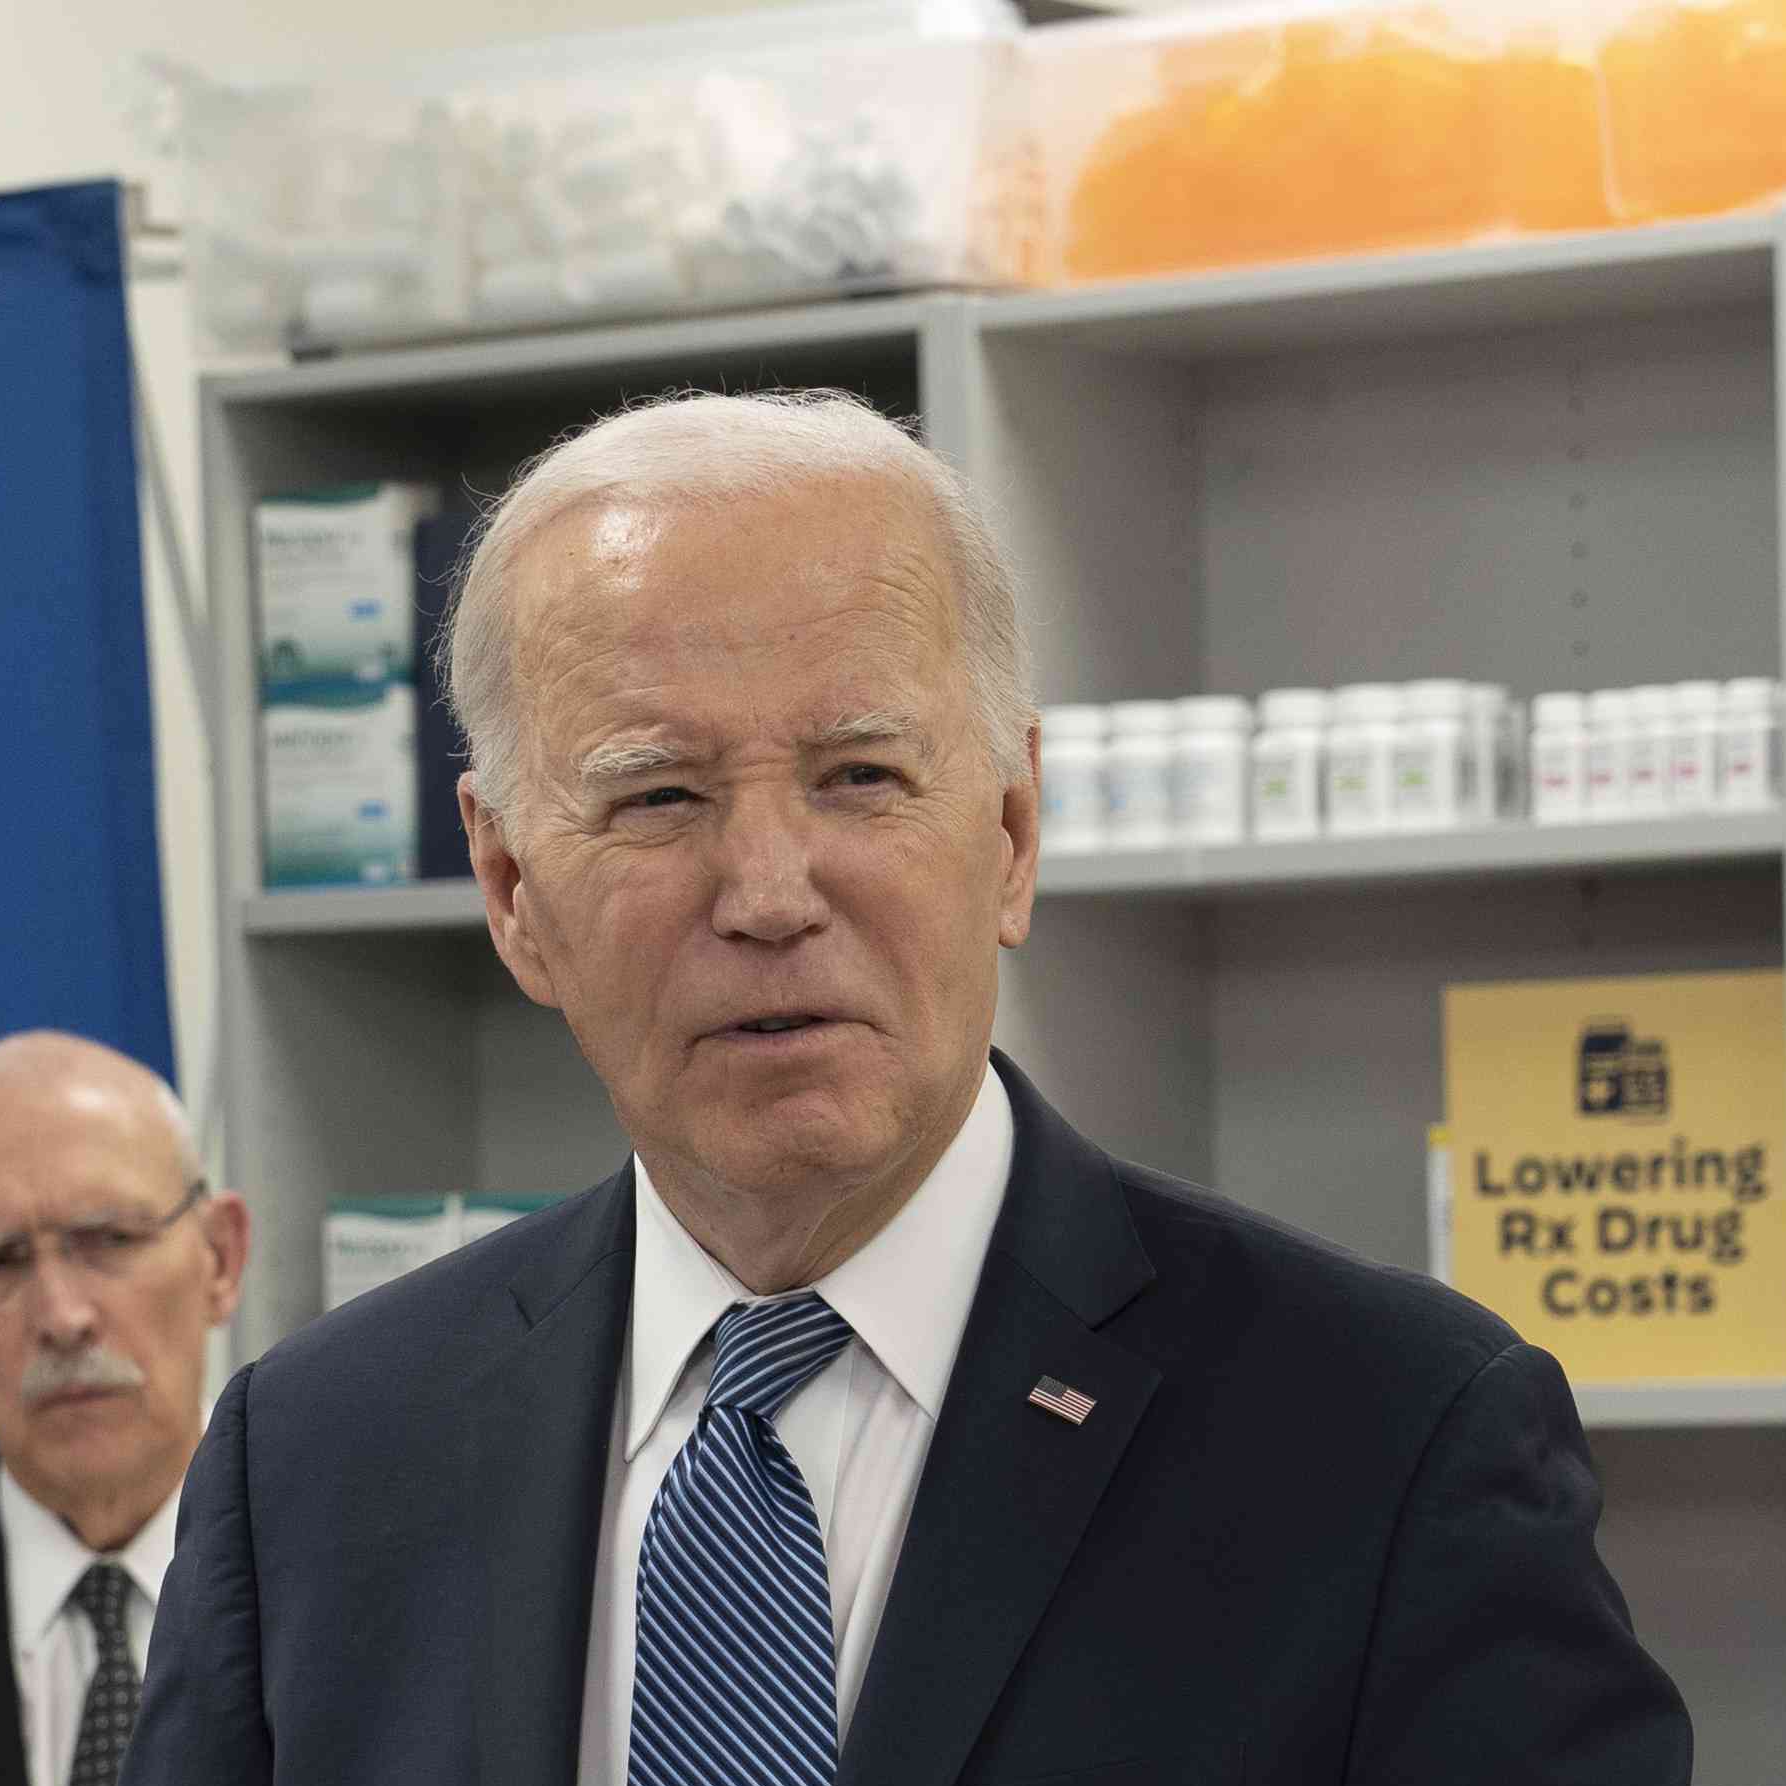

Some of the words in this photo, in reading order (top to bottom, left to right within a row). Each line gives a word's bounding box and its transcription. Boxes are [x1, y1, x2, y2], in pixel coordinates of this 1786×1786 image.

[1474, 1137, 1770, 1203] Lowering
[1499, 1210, 1575, 1257] Rx
[1597, 1208, 1746, 1265] Drug
[1542, 1269, 1715, 1319] Costs
